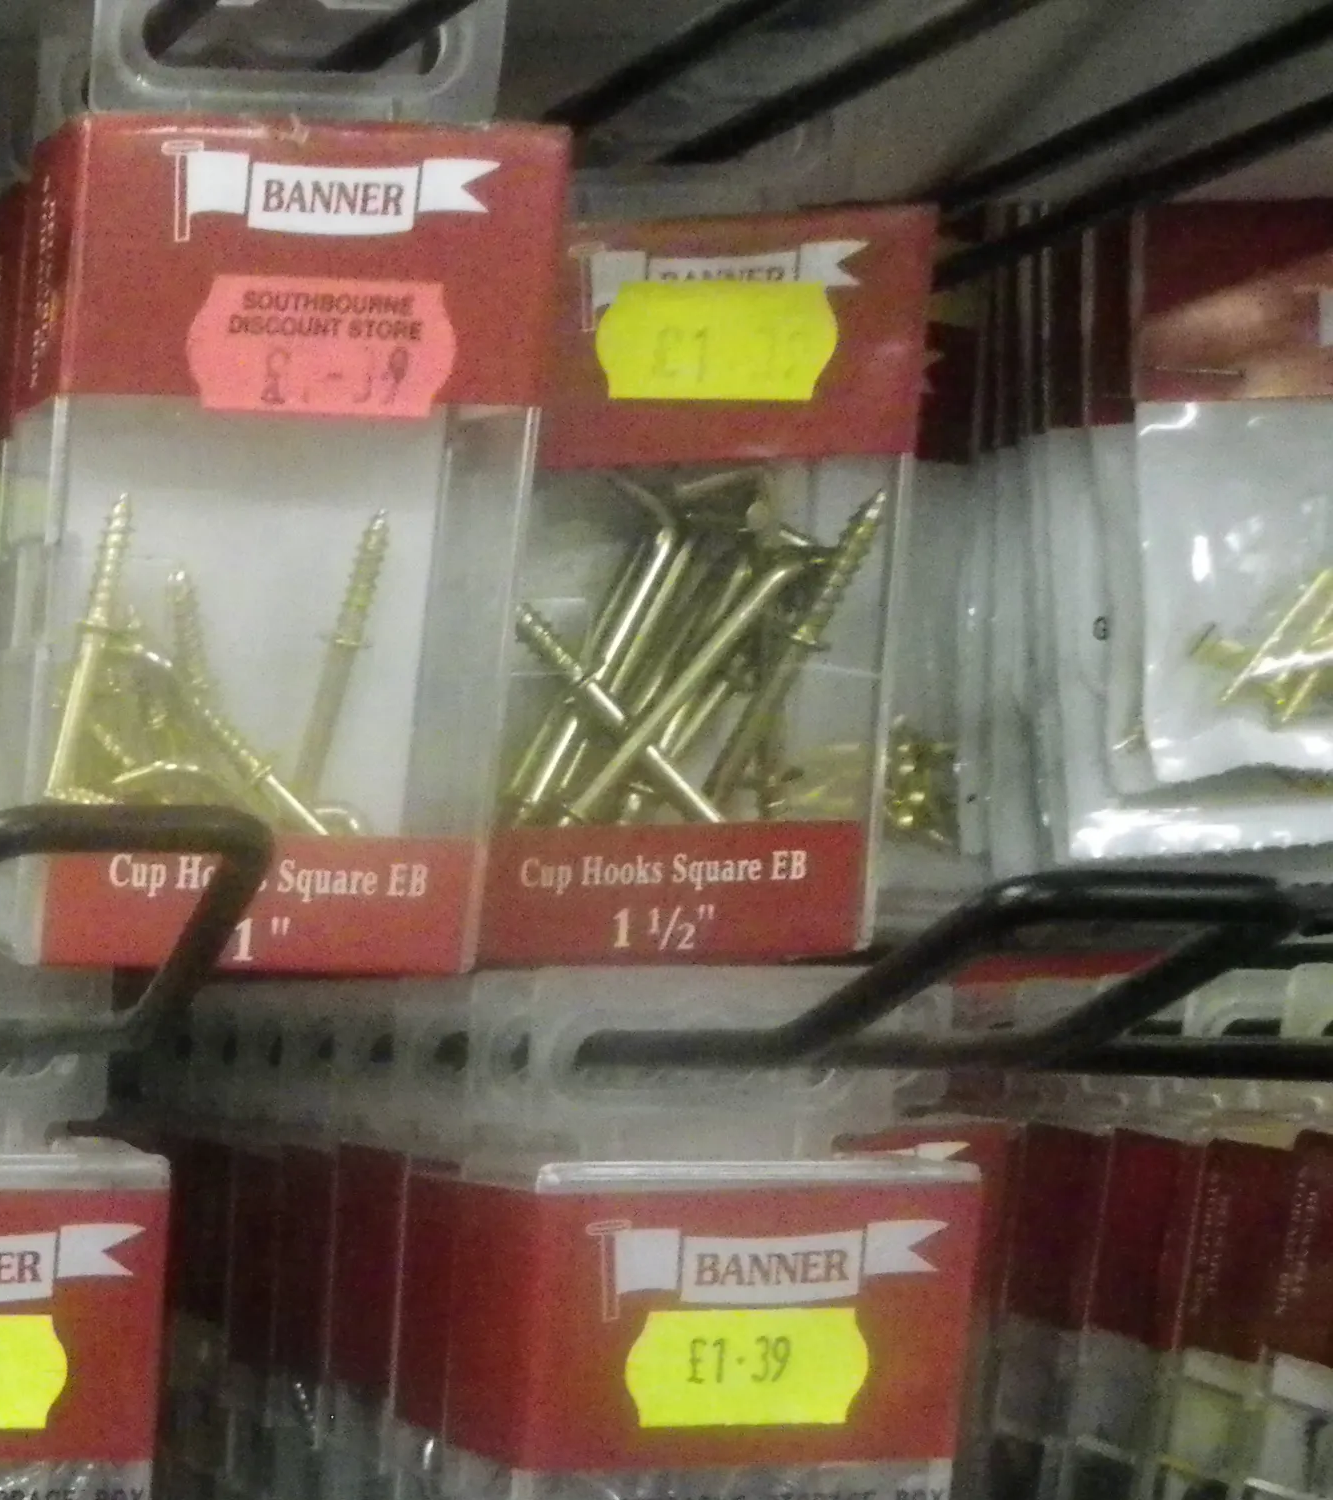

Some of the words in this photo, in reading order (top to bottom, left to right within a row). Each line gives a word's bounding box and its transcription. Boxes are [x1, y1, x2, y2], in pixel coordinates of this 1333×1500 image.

[262, 177, 405, 218] BANNER
[243, 289, 414, 317] SOUTHBOURNE
[226, 316, 344, 340] DISCOUNT
[348, 317, 423, 341] STORE
[109, 853, 167, 897] Cup
[277, 858, 378, 903] Square
[386, 863, 428, 897] EB
[520, 857, 573, 895] Cup
[581, 855, 664, 887] Hooks
[672, 853, 762, 891] Square
[770, 849, 807, 881] EB
[694, 1249, 850, 1287] BANNER
